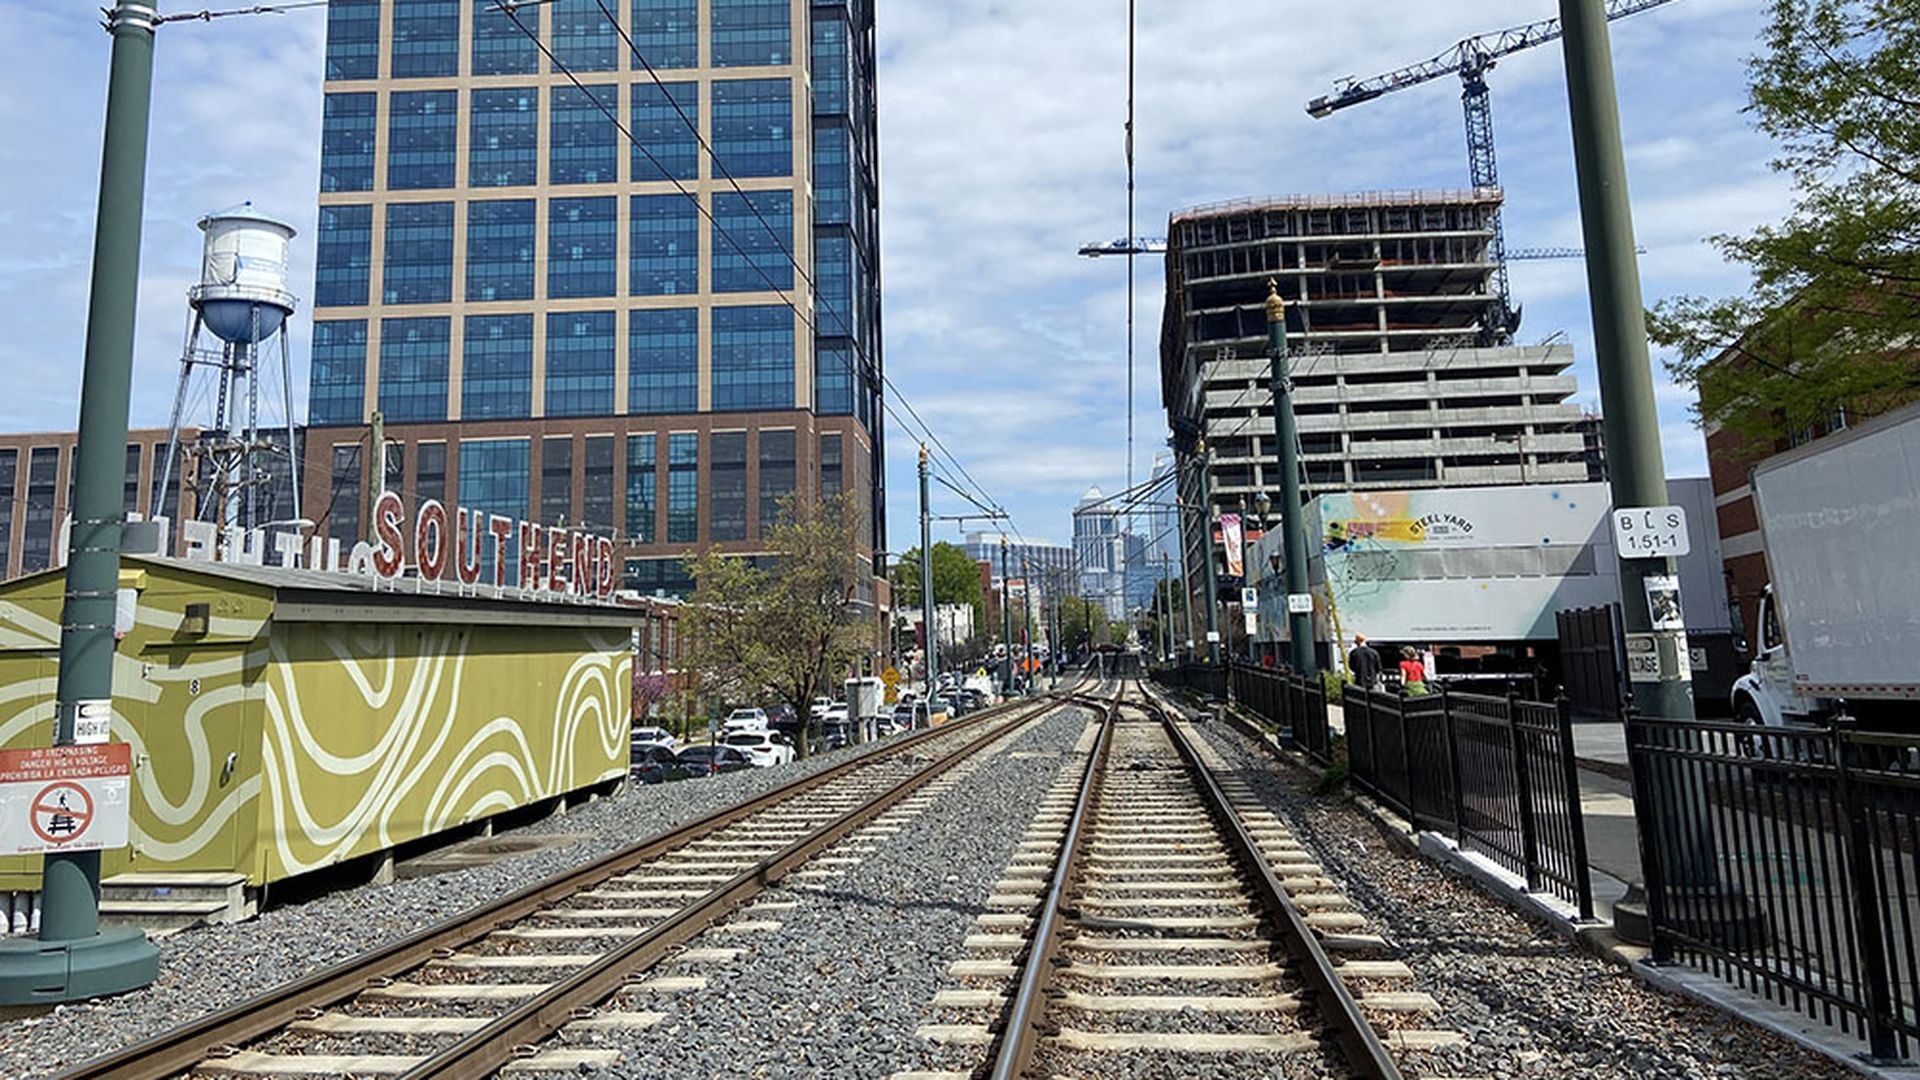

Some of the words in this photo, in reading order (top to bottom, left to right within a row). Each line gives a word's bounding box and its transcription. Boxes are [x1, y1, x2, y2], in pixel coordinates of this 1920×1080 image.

[1409, 514, 1441, 535] STEEL
[1443, 514, 1474, 534] YARD
[1621, 516, 1633, 530] B
[1645, 513, 1655, 528] L
[1667, 514, 1679, 528] S
[372, 491, 615, 598] SOUTHEND
[1628, 534, 1677, 549] 1.51-1
[190, 679, 199, 694] 8
[77, 721, 98, 736] HIGH
[32, 749, 43, 758] NO
[20, 759, 52, 769] DANGER
[54, 758, 73, 767] HIGH
[75, 755, 108, 765] VOLTAGE
[43, 768, 55, 778] LA
